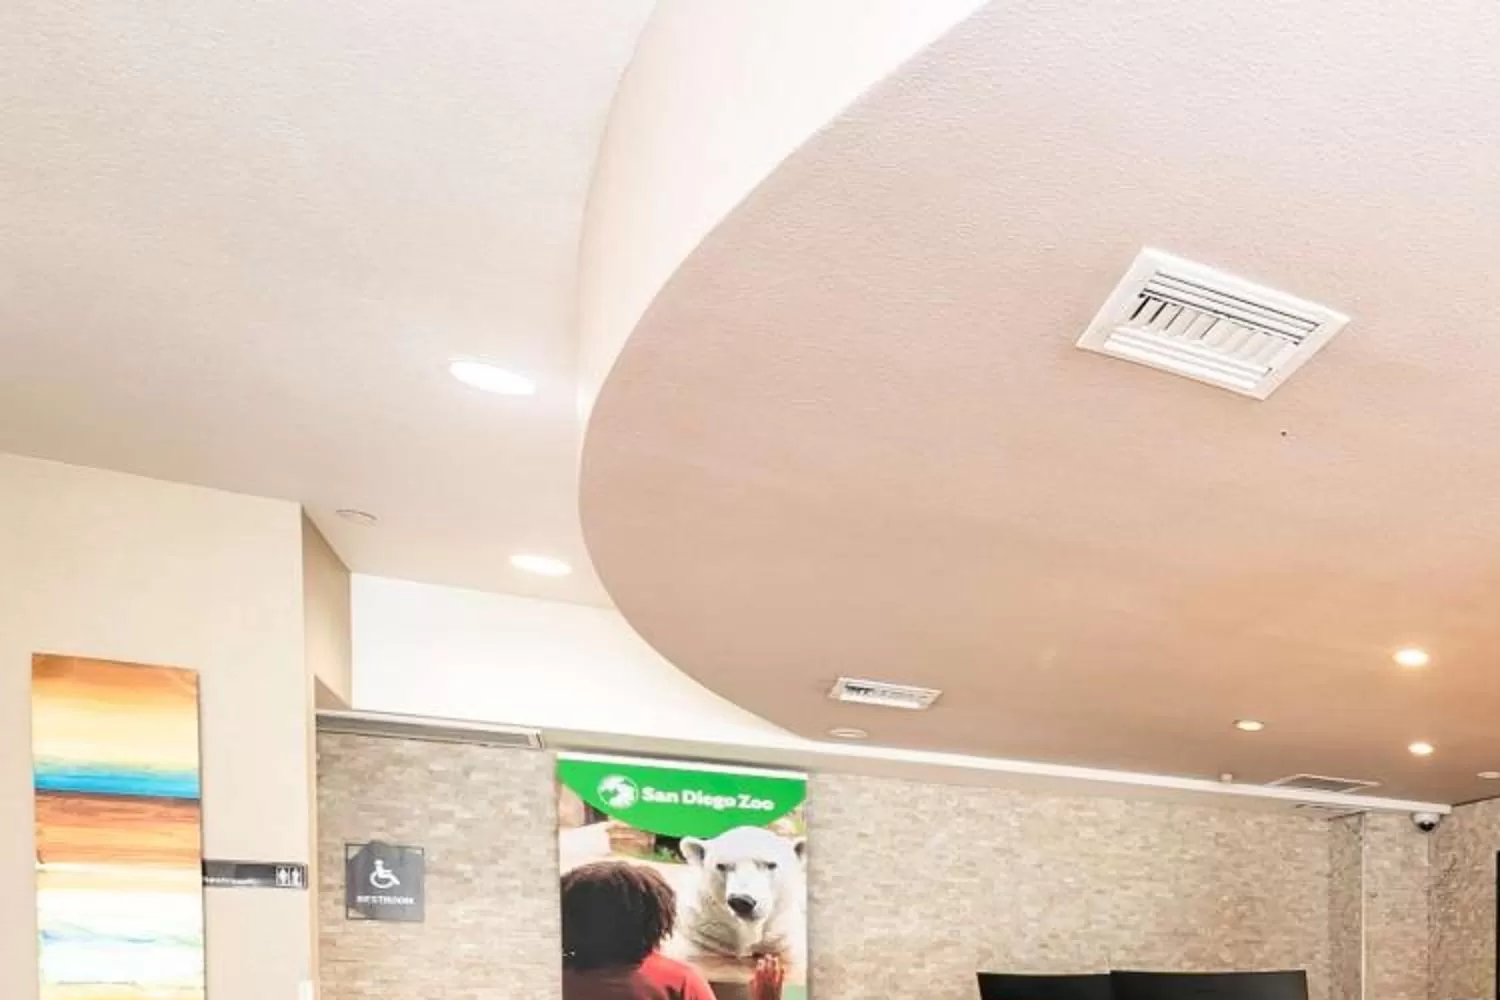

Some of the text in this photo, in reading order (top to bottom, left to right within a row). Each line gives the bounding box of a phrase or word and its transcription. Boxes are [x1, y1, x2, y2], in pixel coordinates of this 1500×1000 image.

[641, 785, 776, 812] San Diego Zoo
